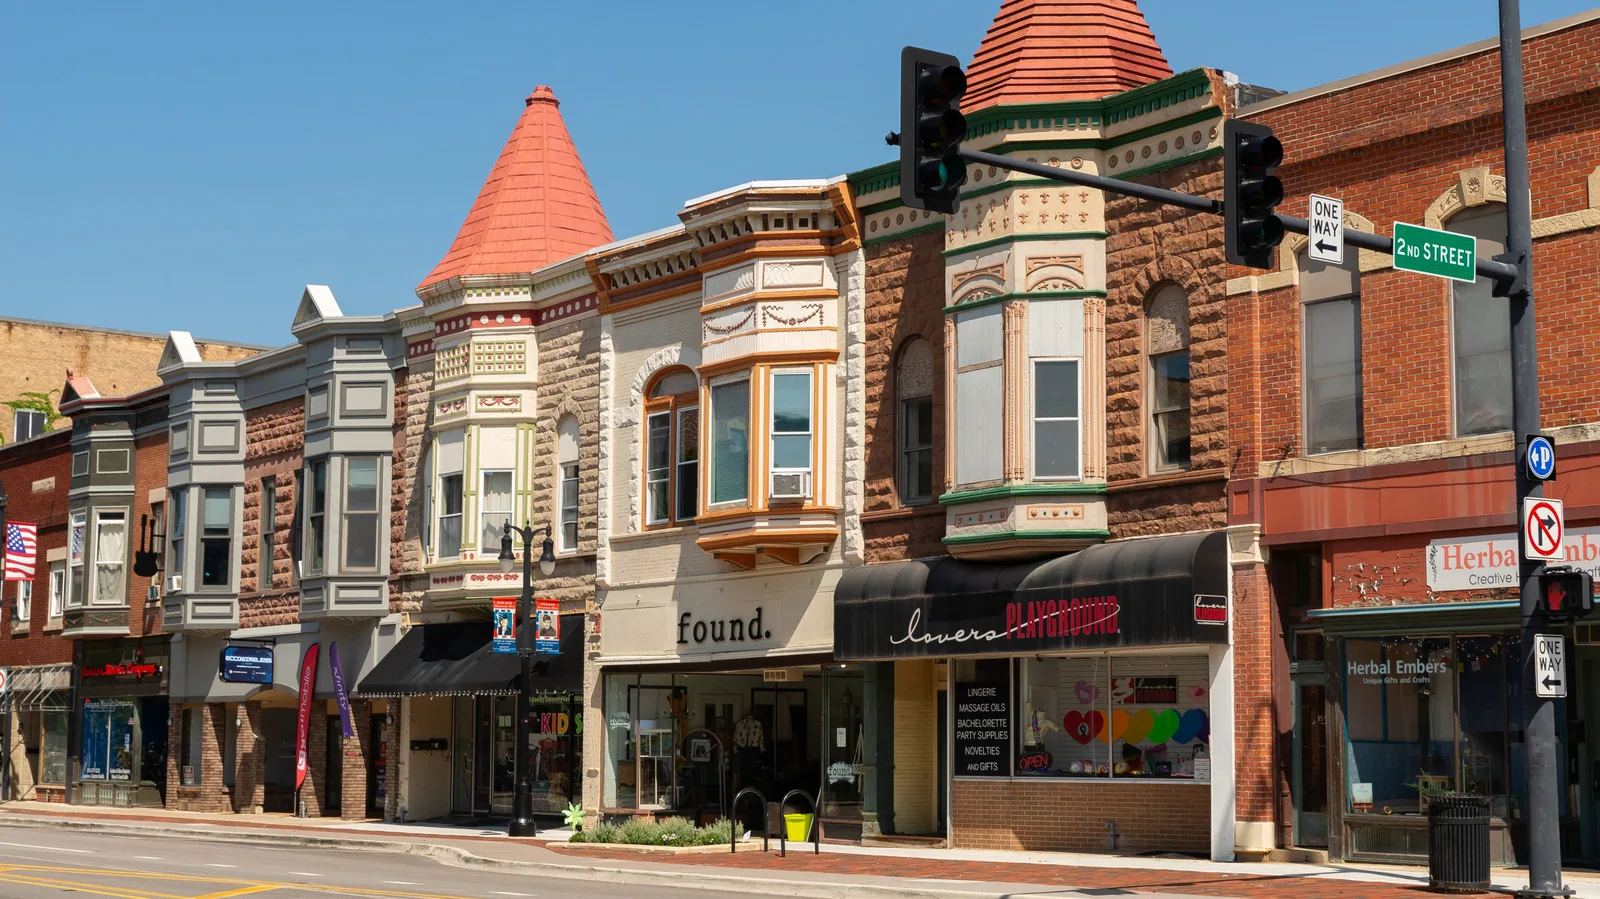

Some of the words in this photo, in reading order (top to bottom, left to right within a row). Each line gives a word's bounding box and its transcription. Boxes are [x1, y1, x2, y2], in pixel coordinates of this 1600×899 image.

[1315, 201, 1338, 220] ONE
[1314, 218, 1339, 238] WAY
[1397, 237, 1420, 258] 2ND
[1423, 242, 1472, 267] STREET
[1540, 446, 1550, 470] P
[1441, 541, 1518, 570] Herba
[1468, 572, 1512, 586] Creative
[676, 606, 771, 644] found.
[890, 608, 1007, 644] lovers
[1540, 640, 1561, 655] ONE
[1347, 659, 1390, 675] Herbal
[1396, 658, 1447, 674] Embers
[1539, 657, 1562, 672] WAY
[1384, 676, 1398, 684] Gifts
[1400, 676, 1411, 684] and
[1412, 676, 1431, 684] Crafts
[333, 666, 347, 710] xfinity
[967, 687, 997, 697] LINGERIE
[959, 703, 990, 712] MASSAGE
[990, 702, 1006, 712] OILS
[957, 718, 1007, 728] BACHELORETTE
[956, 731, 976, 740] PARTY
[977, 730, 1008, 740] SUPPLIES
[964, 746, 1000, 756] NOVELTIES
[967, 763, 979, 771] AND
[979, 762, 998, 771] GIFTS
[1020, 754, 1048, 770] OPEN
